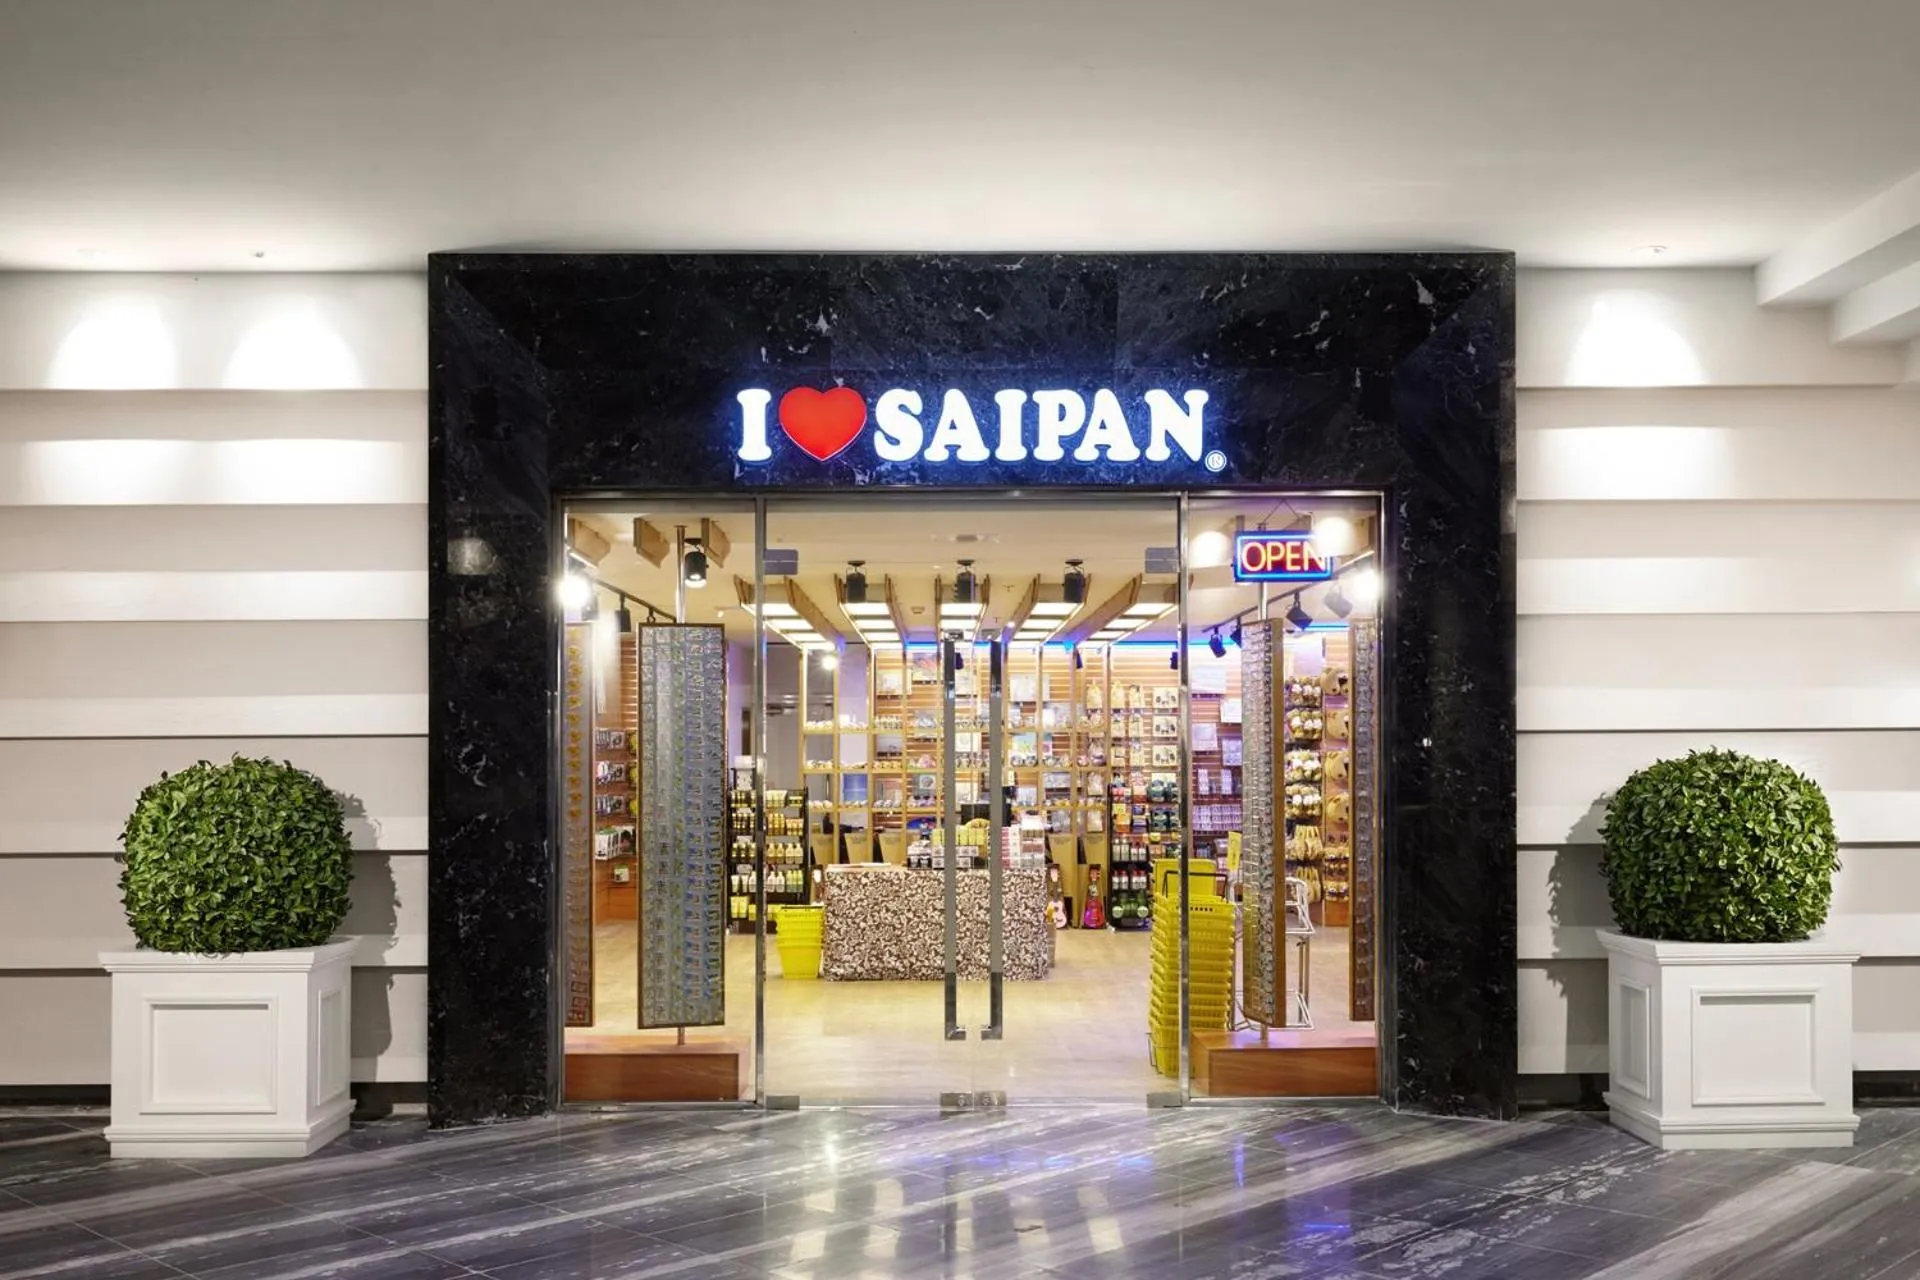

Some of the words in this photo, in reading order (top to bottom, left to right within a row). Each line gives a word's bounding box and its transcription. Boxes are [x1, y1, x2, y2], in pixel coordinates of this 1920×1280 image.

[737, 388, 771, 462] I
[873, 388, 1209, 462] SAIPAN
[1241, 541, 1325, 572] OPEN
